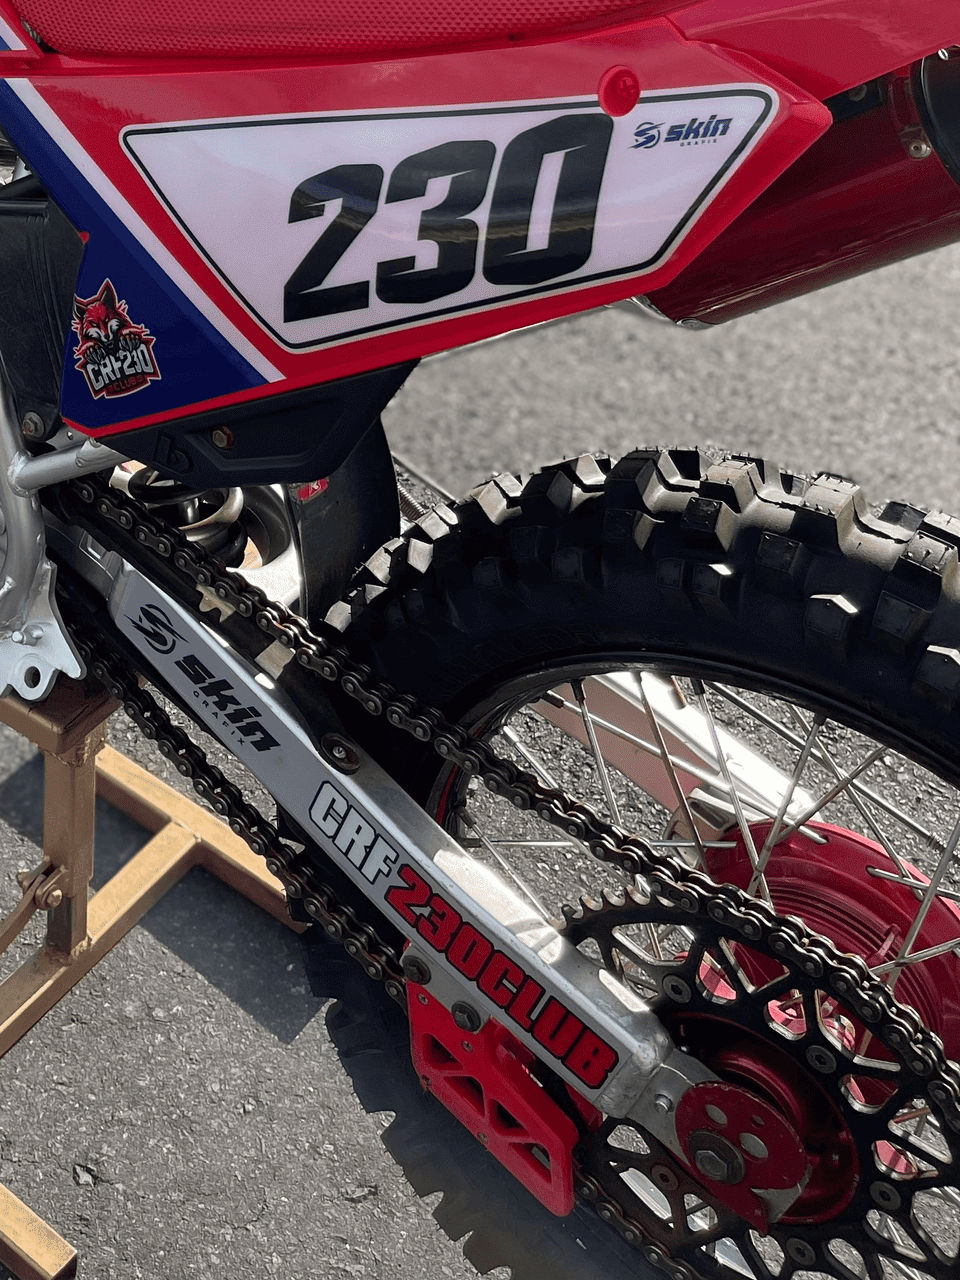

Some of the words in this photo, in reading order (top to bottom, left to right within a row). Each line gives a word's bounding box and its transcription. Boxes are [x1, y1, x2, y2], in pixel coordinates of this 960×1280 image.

[663, 114, 733, 143] skin
[283, 113, 614, 323] 230
[174, 654, 281, 752] skin
[193, 690, 245, 746] GRAFIX
[308, 780, 401, 885] CRF
[384, 863, 620, 1090] 230CLUB
